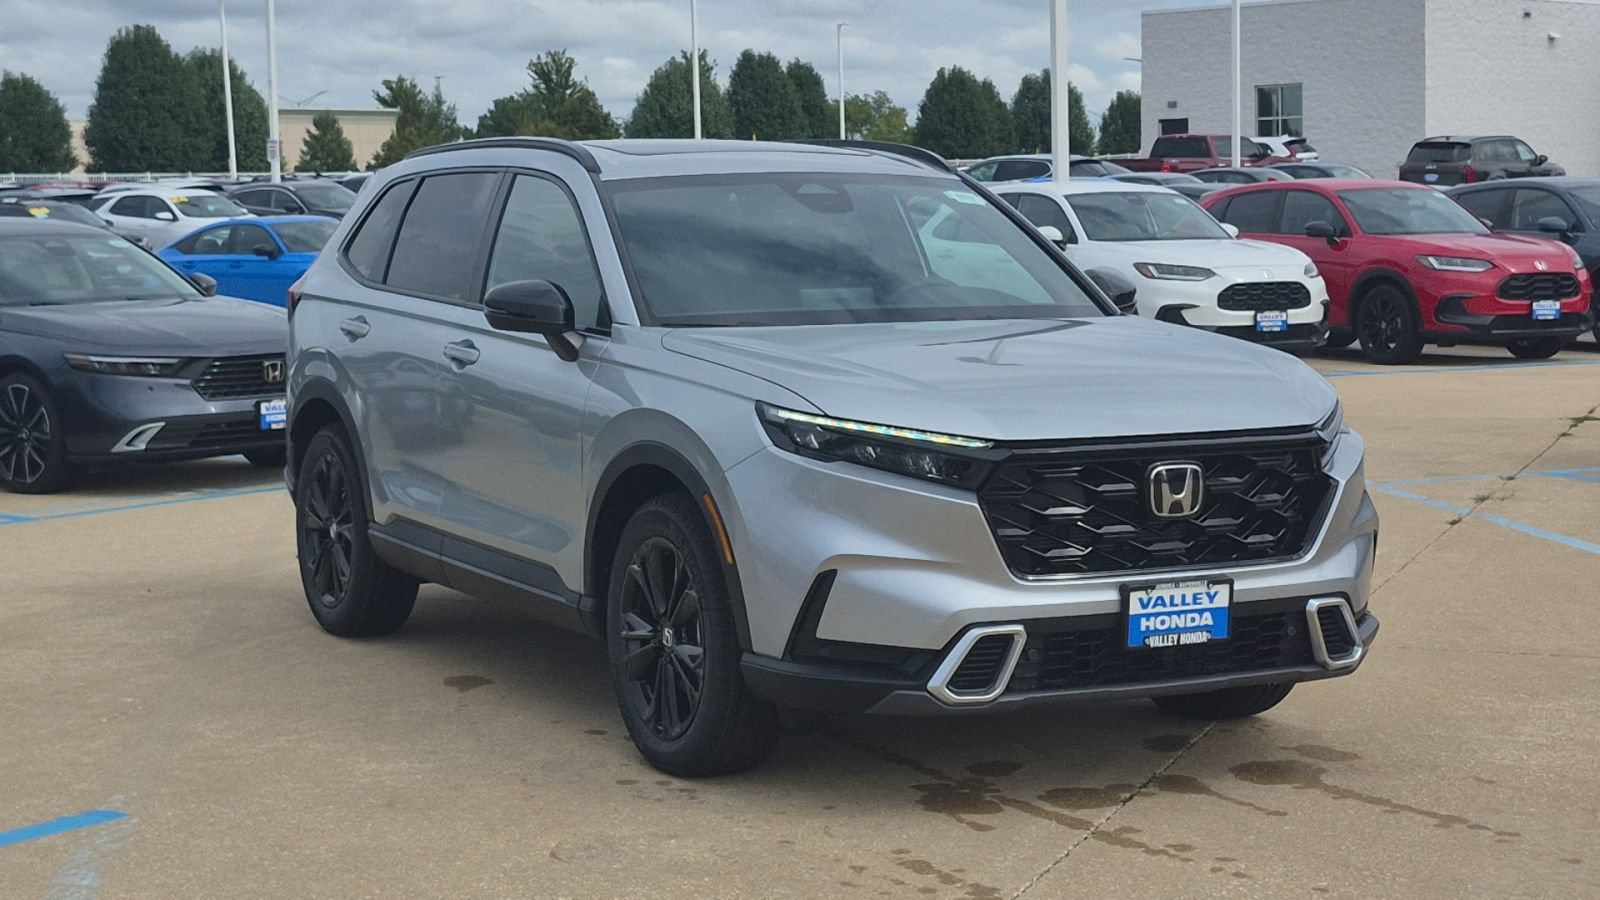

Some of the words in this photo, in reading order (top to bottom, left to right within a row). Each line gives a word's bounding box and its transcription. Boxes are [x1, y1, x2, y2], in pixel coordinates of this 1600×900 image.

[1138, 590, 1219, 610] VALLEY
[1140, 611, 1214, 631] HONDA
[1150, 633, 1178, 648] VALLEY
[1180, 631, 1208, 645] HONDA
